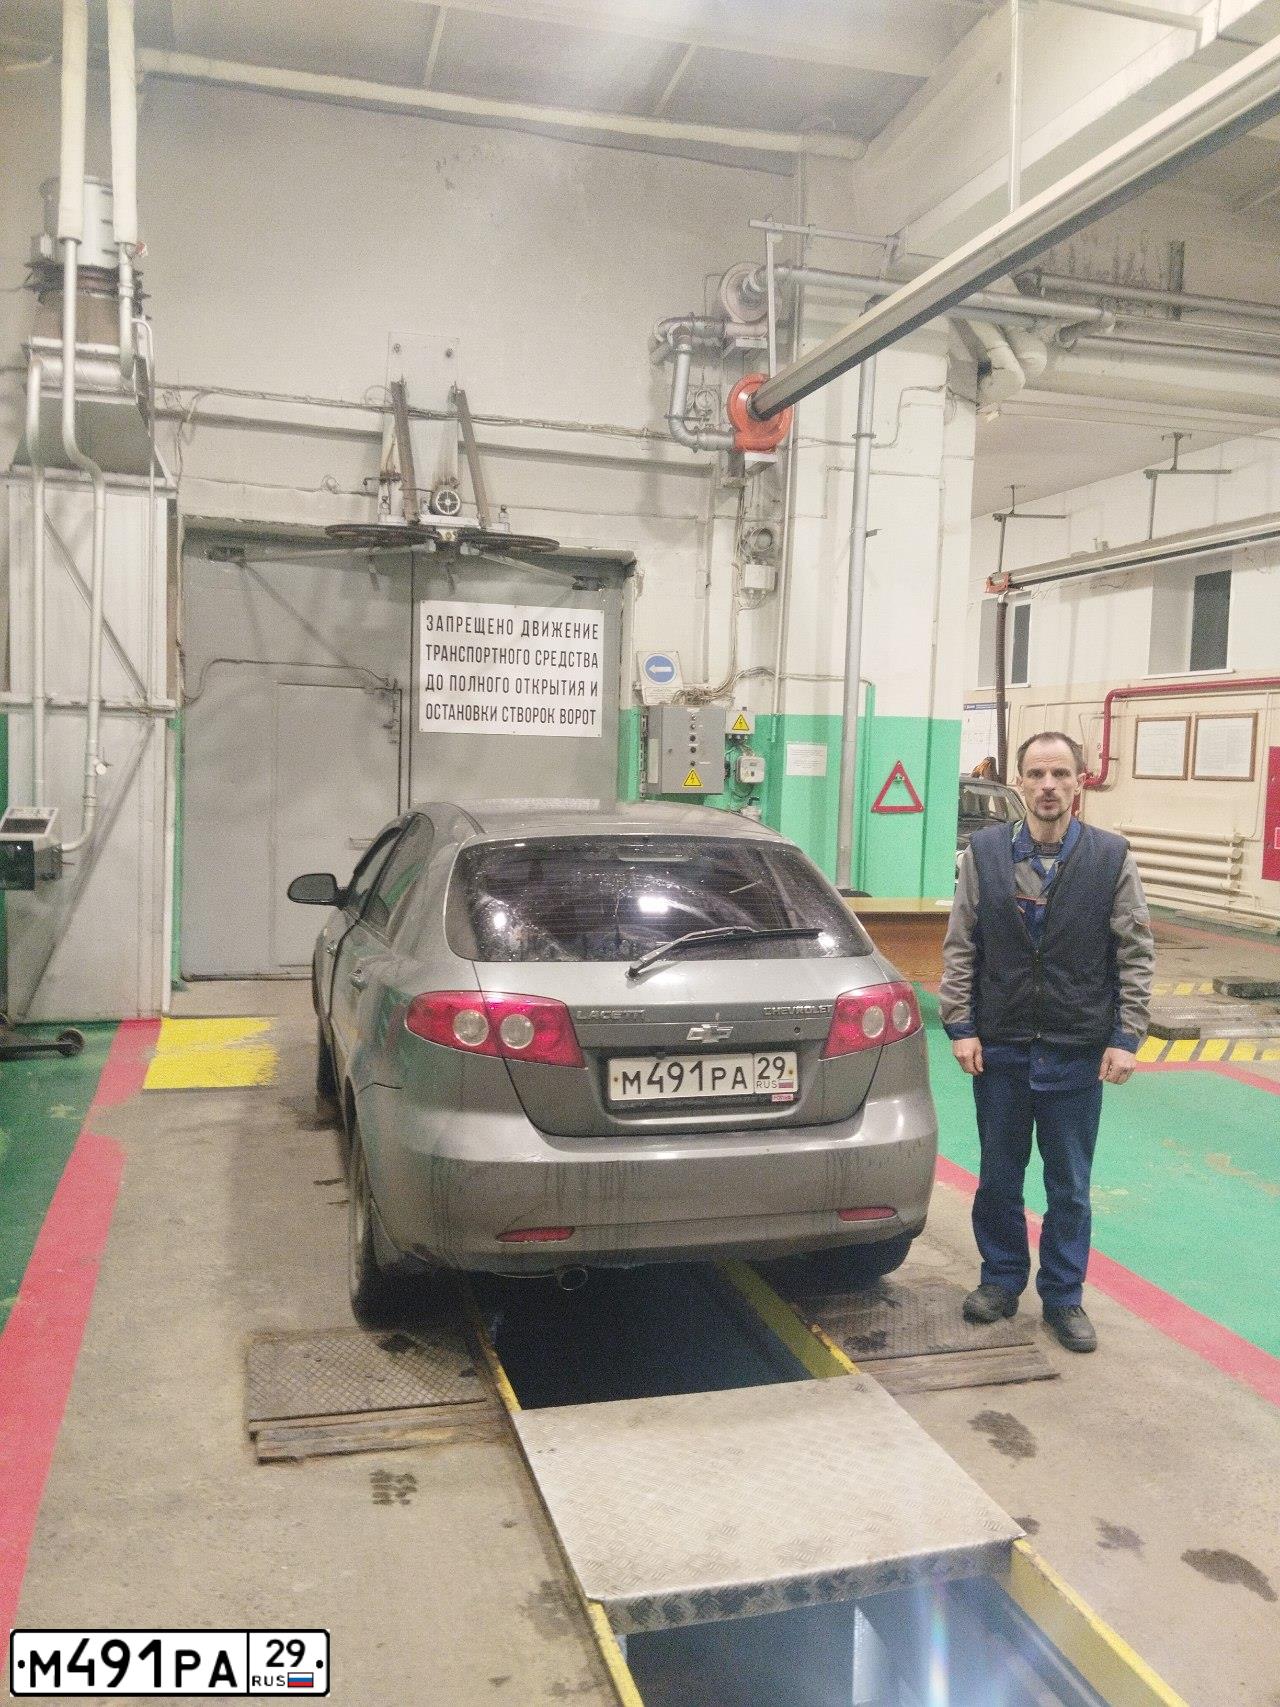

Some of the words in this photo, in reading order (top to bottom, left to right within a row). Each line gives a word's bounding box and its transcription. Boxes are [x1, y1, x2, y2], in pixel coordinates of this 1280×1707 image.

[426, 614, 514, 636] ЗАПРЕЩЕНО
[520, 619, 599, 640] ДВИЖЕНИЕ
[425, 644, 530, 666] ТРАНСПОРТНОГО
[535, 649, 599, 669] СРЕДСТВА
[425, 674, 444, 693] ДО
[449, 675, 510, 694] ПОЛНОГО
[515, 678, 585, 697] ОТКРЫТИЯ
[590, 681, 598, 697] И
[425, 703, 498, 722] ОСТАНОВКИ
[502, 705, 555, 724] СТВОРОК
[559, 708, 597, 726] ВОРОТ
[757, 1056, 786, 1080] 29
[756, 1080, 778, 1089] RUS
